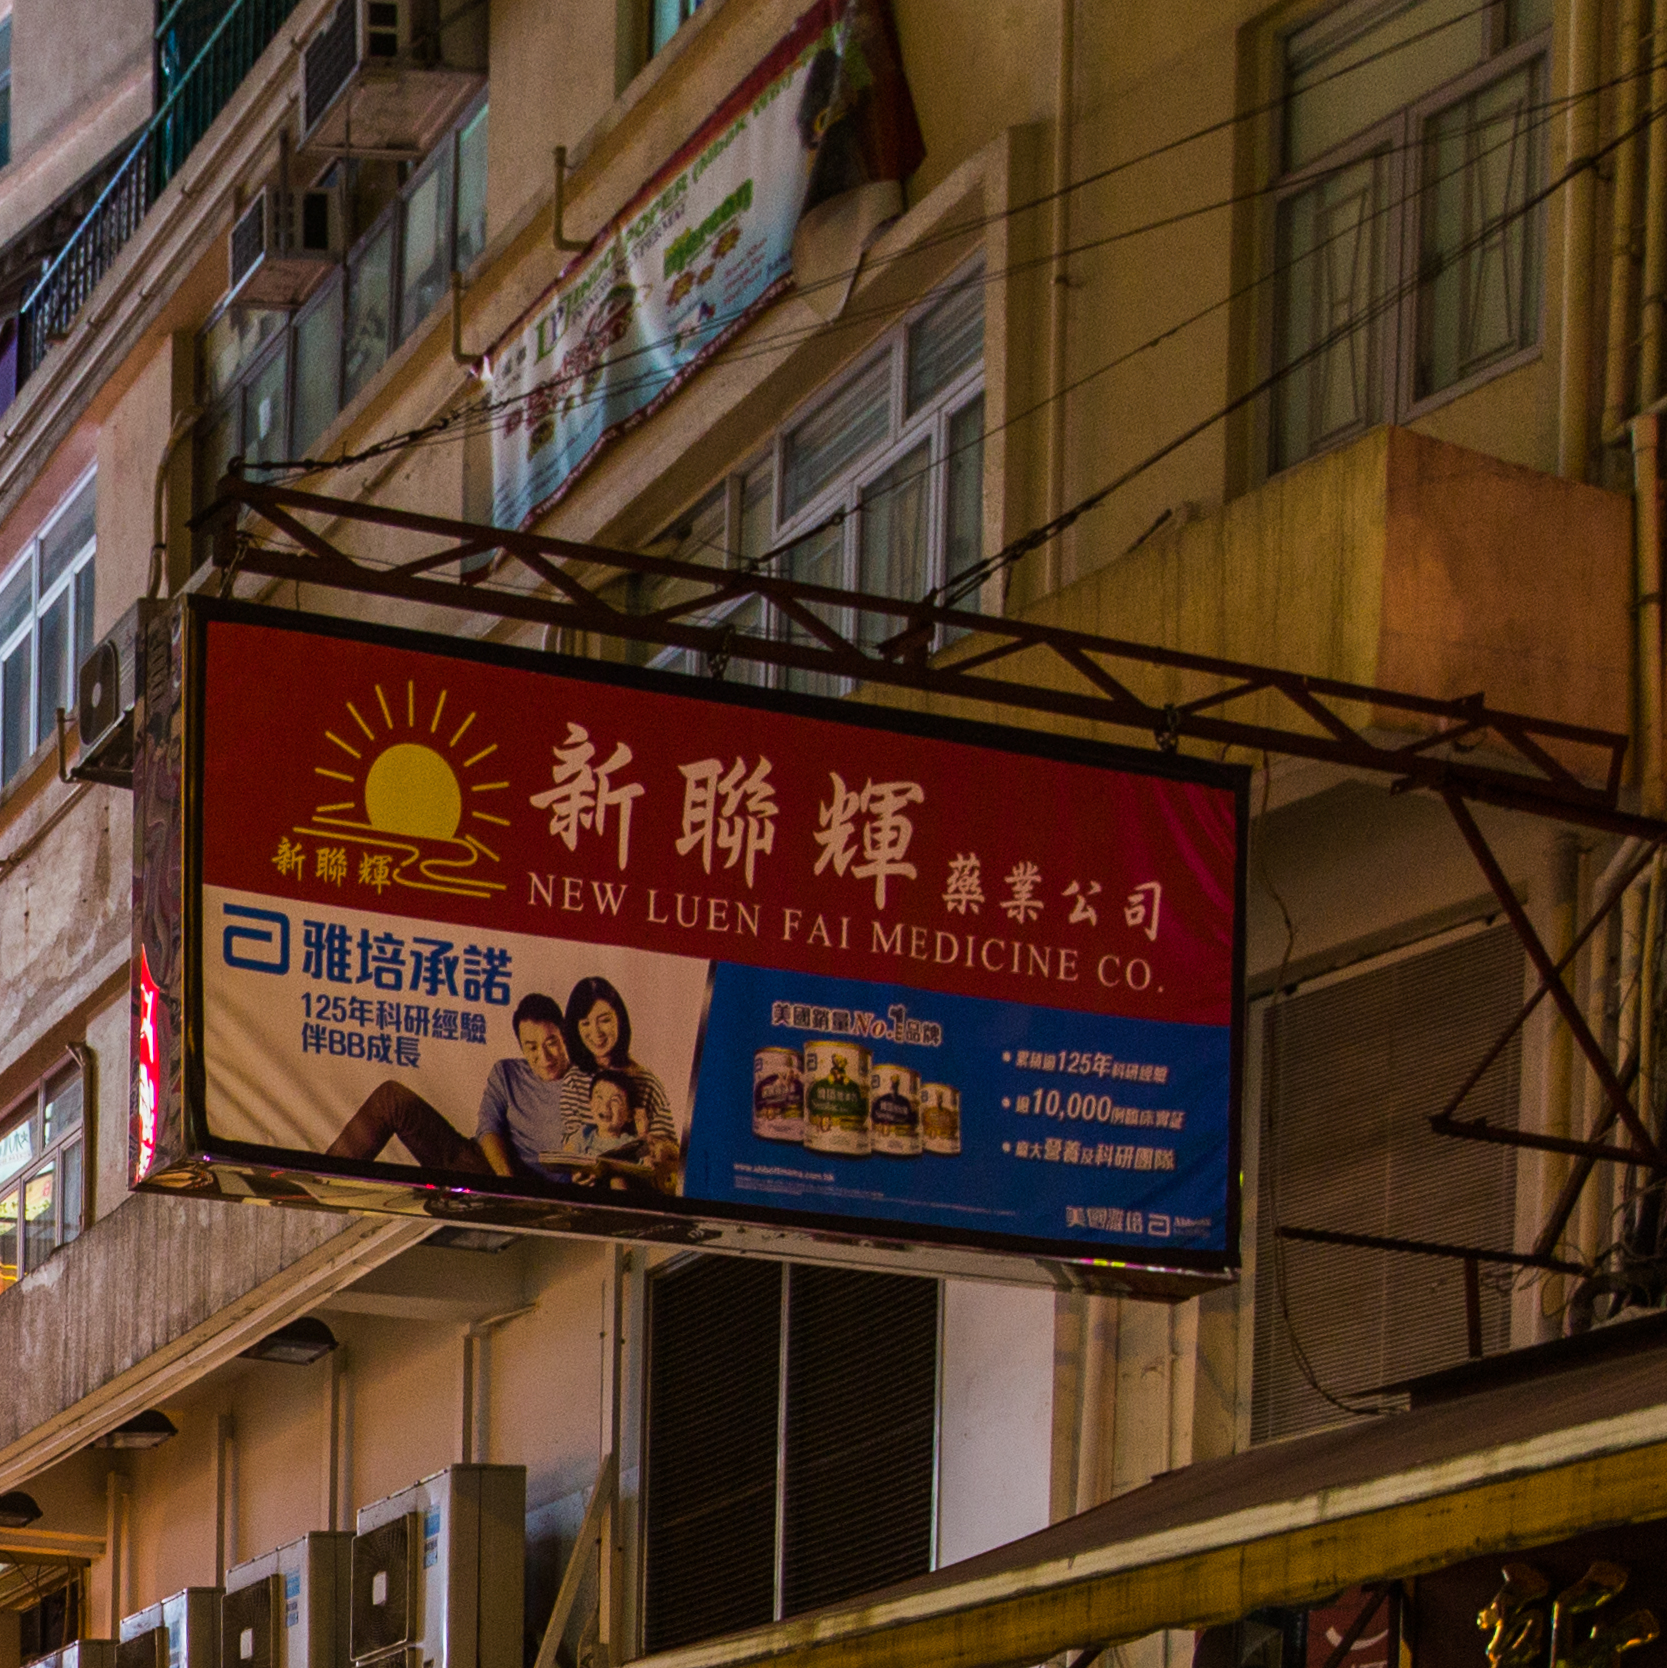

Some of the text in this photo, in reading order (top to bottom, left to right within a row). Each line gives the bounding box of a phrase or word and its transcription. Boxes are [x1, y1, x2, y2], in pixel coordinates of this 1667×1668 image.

[270, 837, 392, 893] 新聯輝
[530, 722, 1162, 941] 新聯輝 藥業公司
[302, 919, 513, 1006] 雅培承諾
[529, 872, 1165, 993] NEW LUEN FAI MEDICINE CO.
[301, 992, 487, 1045] 125年科研經驗
[301, 1023, 421, 1069] 伴BB成長
